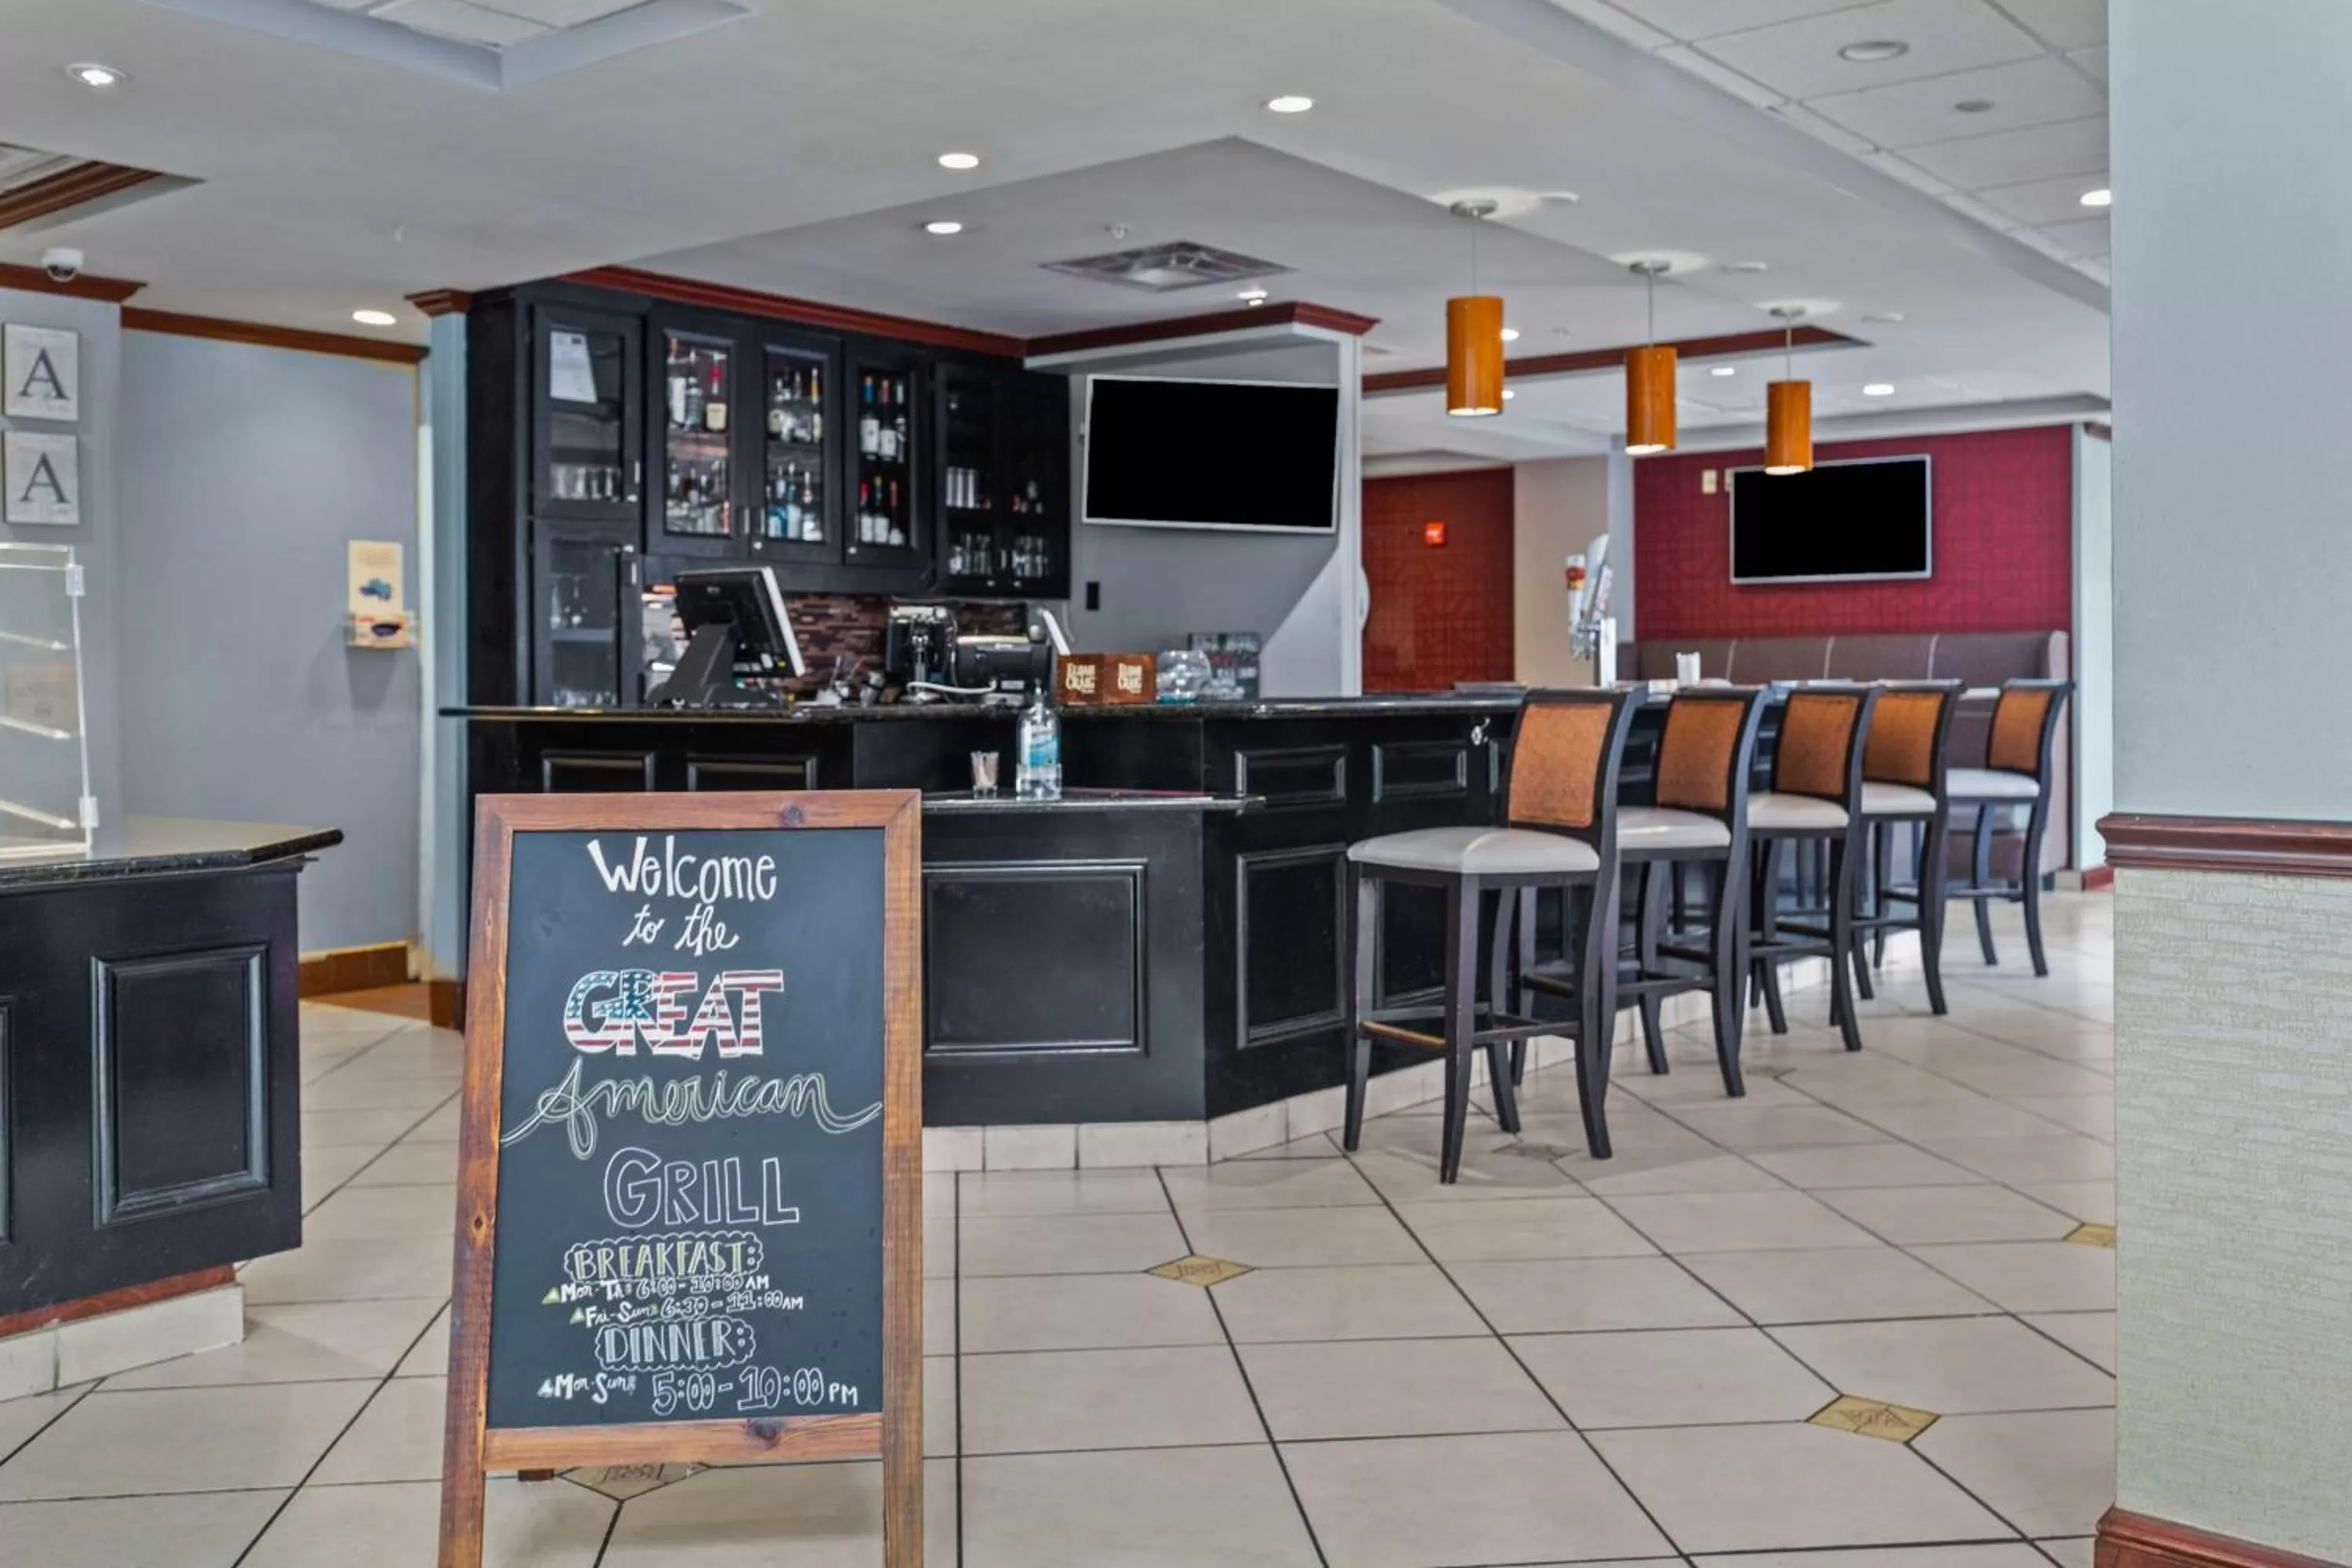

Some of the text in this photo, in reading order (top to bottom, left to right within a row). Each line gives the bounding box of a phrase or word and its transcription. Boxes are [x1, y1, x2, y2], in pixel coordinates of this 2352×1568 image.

[18, 347, 71, 399] A
[20, 452, 71, 503] A
[586, 835, 777, 903] Welcome
[622, 903, 739, 956] to the
[563, 969, 784, 1060] GREAT
[500, 1056, 882, 1160] American
[604, 1147, 799, 1229] GRILL
[574, 1240, 756, 1281] BREAKFAST:
[746, 1275, 769, 1290] AM
[604, 1319, 746, 1363] DINNER:
[829, 1382, 858, 1406] PM
